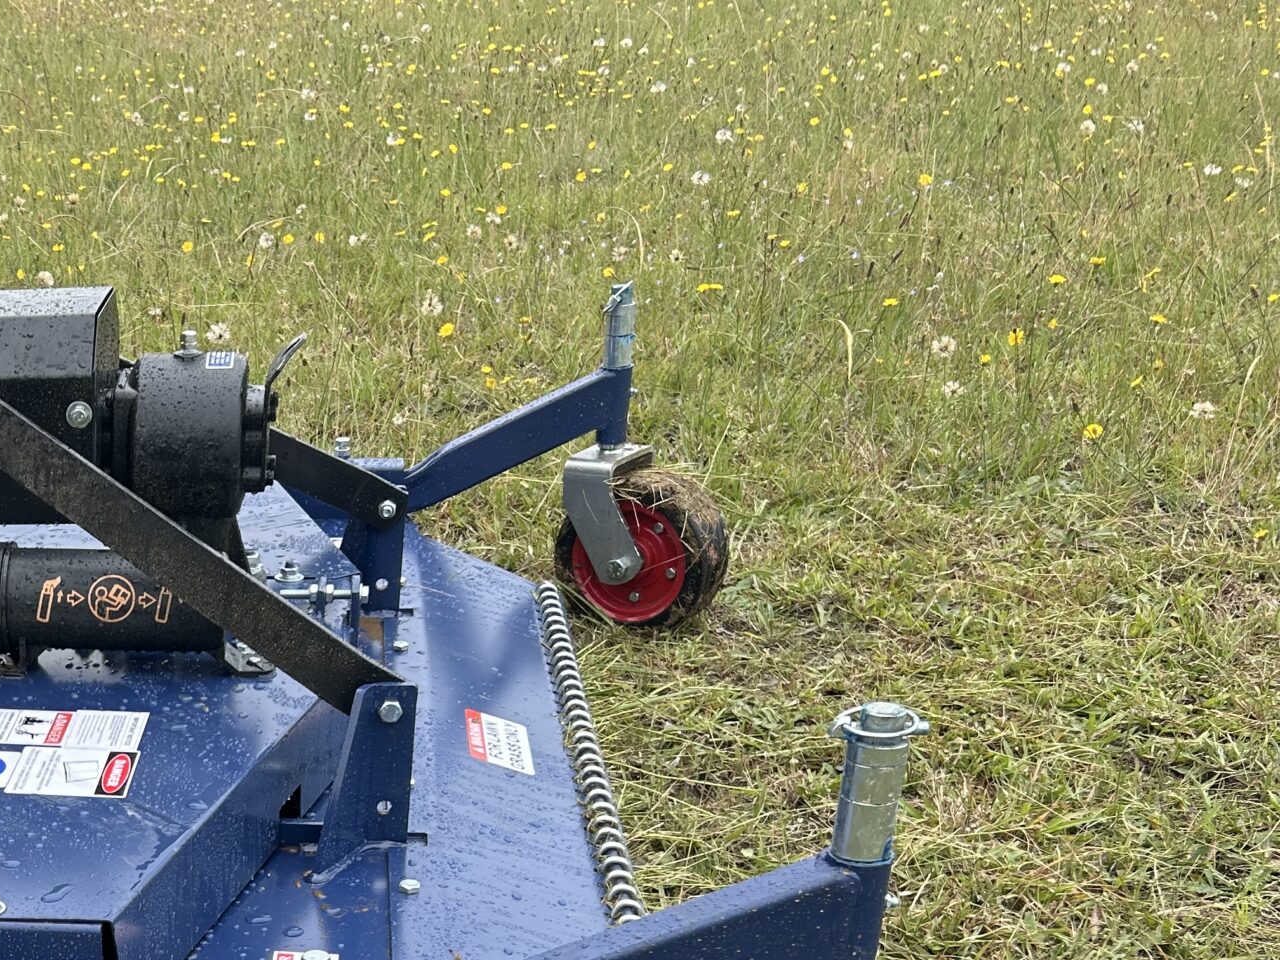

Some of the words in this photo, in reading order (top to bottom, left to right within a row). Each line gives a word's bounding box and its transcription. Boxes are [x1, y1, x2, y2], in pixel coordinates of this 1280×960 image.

[47, 718, 67, 742] DANGER
[488, 742, 503, 760] FOR
[507, 742, 525, 769] GRASS
[105, 758, 127, 787] DANGER
